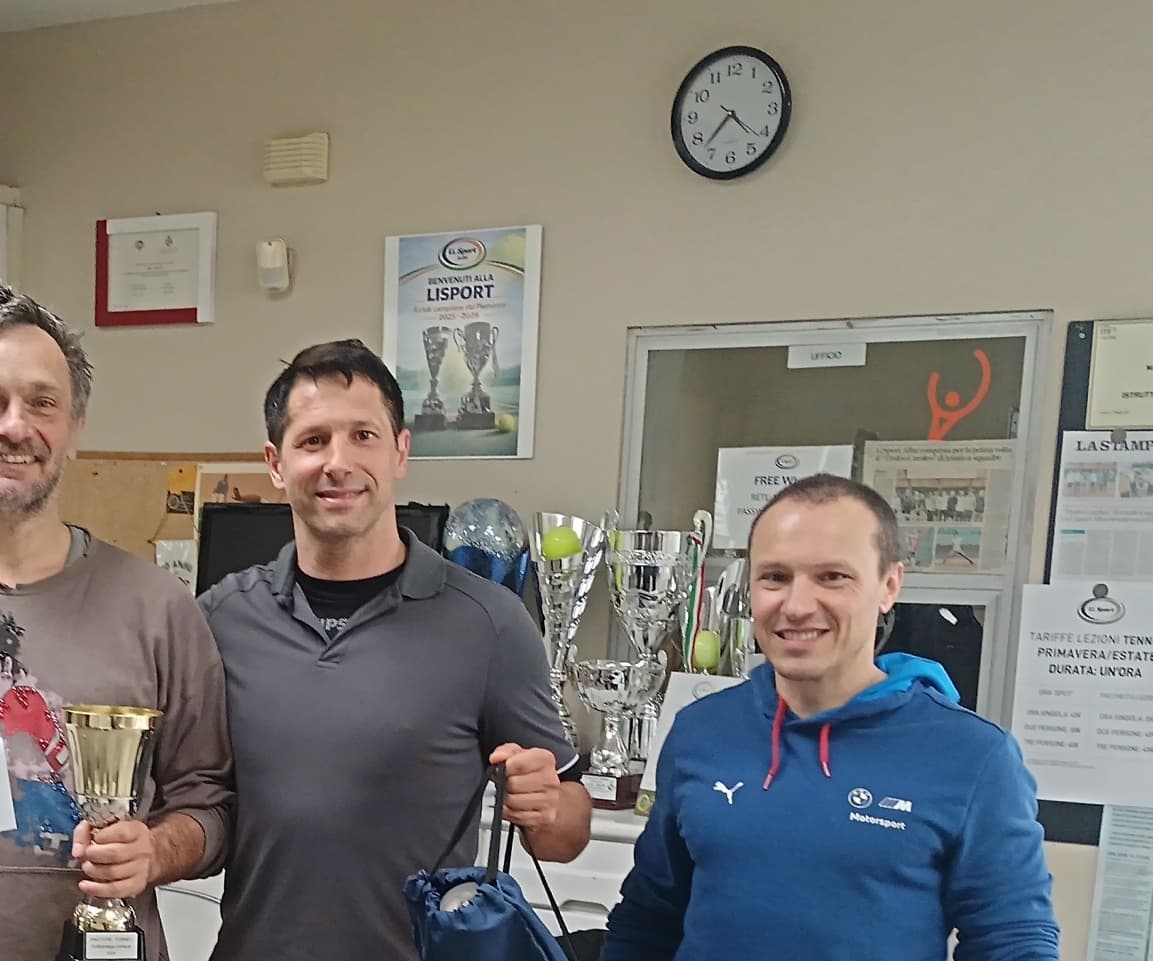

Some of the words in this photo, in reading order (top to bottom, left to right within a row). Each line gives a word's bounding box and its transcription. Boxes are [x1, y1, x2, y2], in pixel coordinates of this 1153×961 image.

[727, 62, 743, 77] 12
[751, 66, 757, 79] 1
[710, 71, 721, 84] 11
[762, 81, 773, 94] 2
[695, 89, 710, 103] 10
[767, 102, 778, 115] 3
[687, 111, 698, 125] 9
[760, 125, 769, 137] 4
[692, 131, 703, 146] 8
[707, 147, 716, 160] 7
[746, 142, 757, 156] 5
[725, 151, 736, 164] 6
[428, 276, 473, 286] BENVENUTI
[474, 274, 494, 282] ALLA
[427, 285, 495, 301] LISPORT
[1076, 440, 1097, 451] LA
[754, 476, 780, 486] FREE
[1030, 631, 1073, 643] TARIFFE
[1077, 633, 1120, 645] LEZIONI
[1048, 663, 1097, 676] DURATA:
[1099, 666, 1143, 678] UN'ORA
[849, 812, 907, 830] Motorsport
